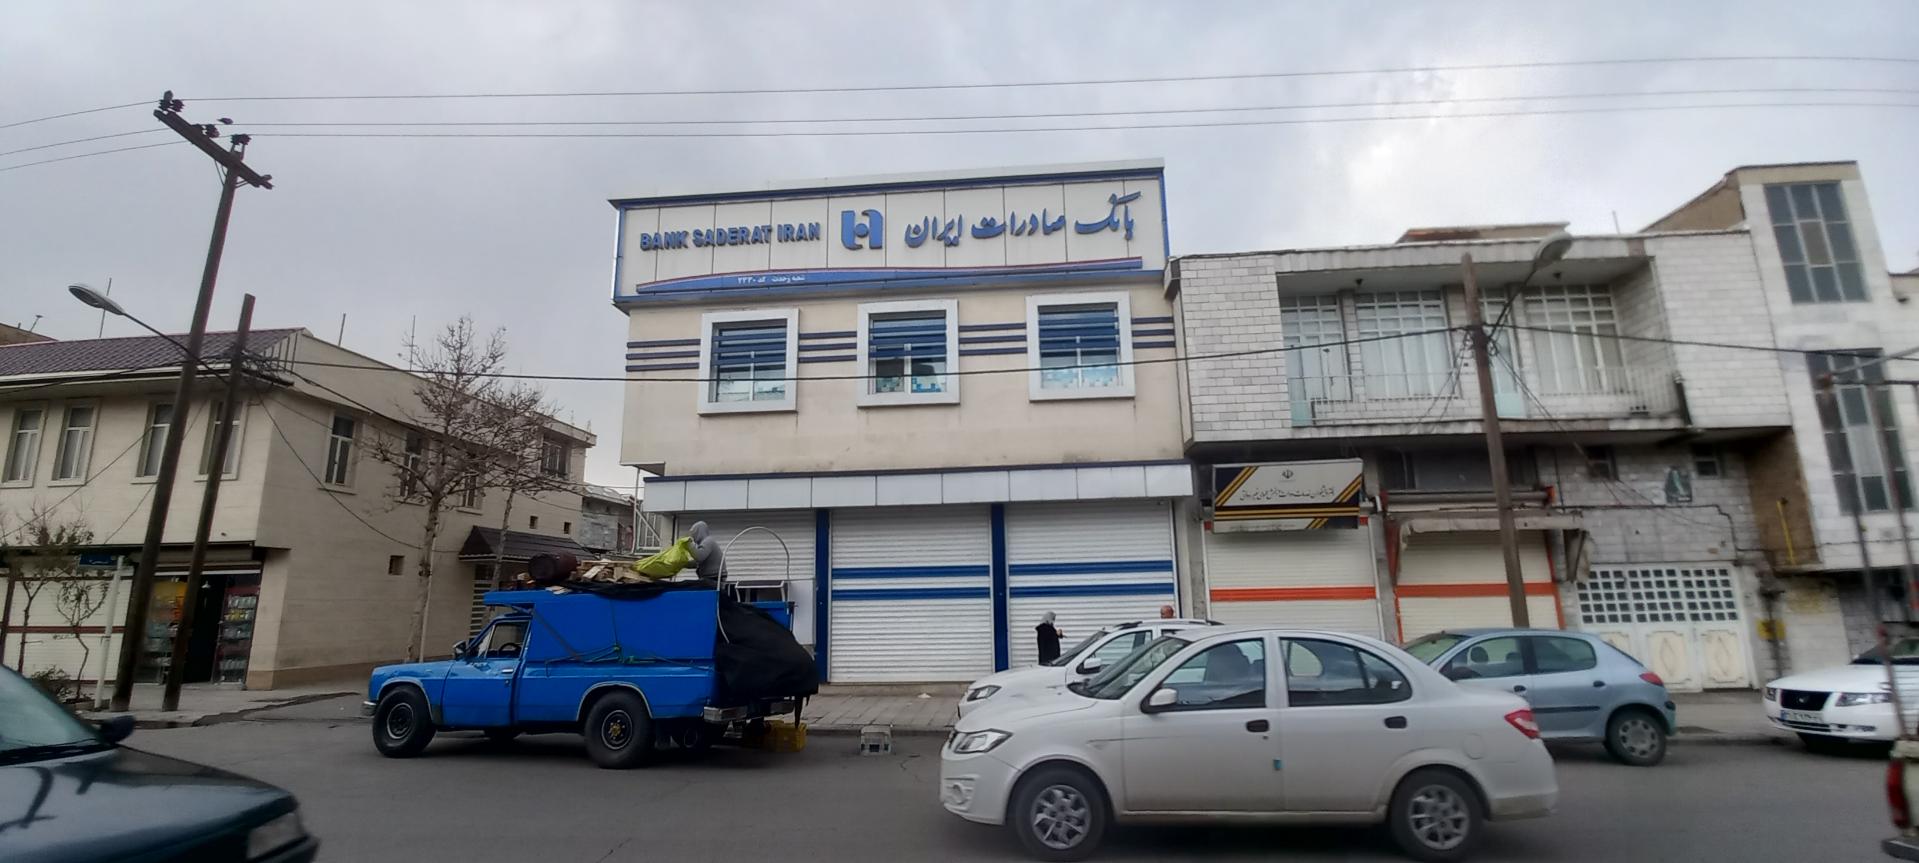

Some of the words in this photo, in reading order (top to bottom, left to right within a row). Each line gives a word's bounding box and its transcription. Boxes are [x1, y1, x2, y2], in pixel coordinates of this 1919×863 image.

[904, 213, 962, 248] ایران
[971, 207, 1067, 239] صادرات
[1074, 191, 1141, 241] بانک
[641, 231, 688, 251] BANK
[693, 225, 772, 247] SADERAT
[777, 222, 821, 243] IRAN
